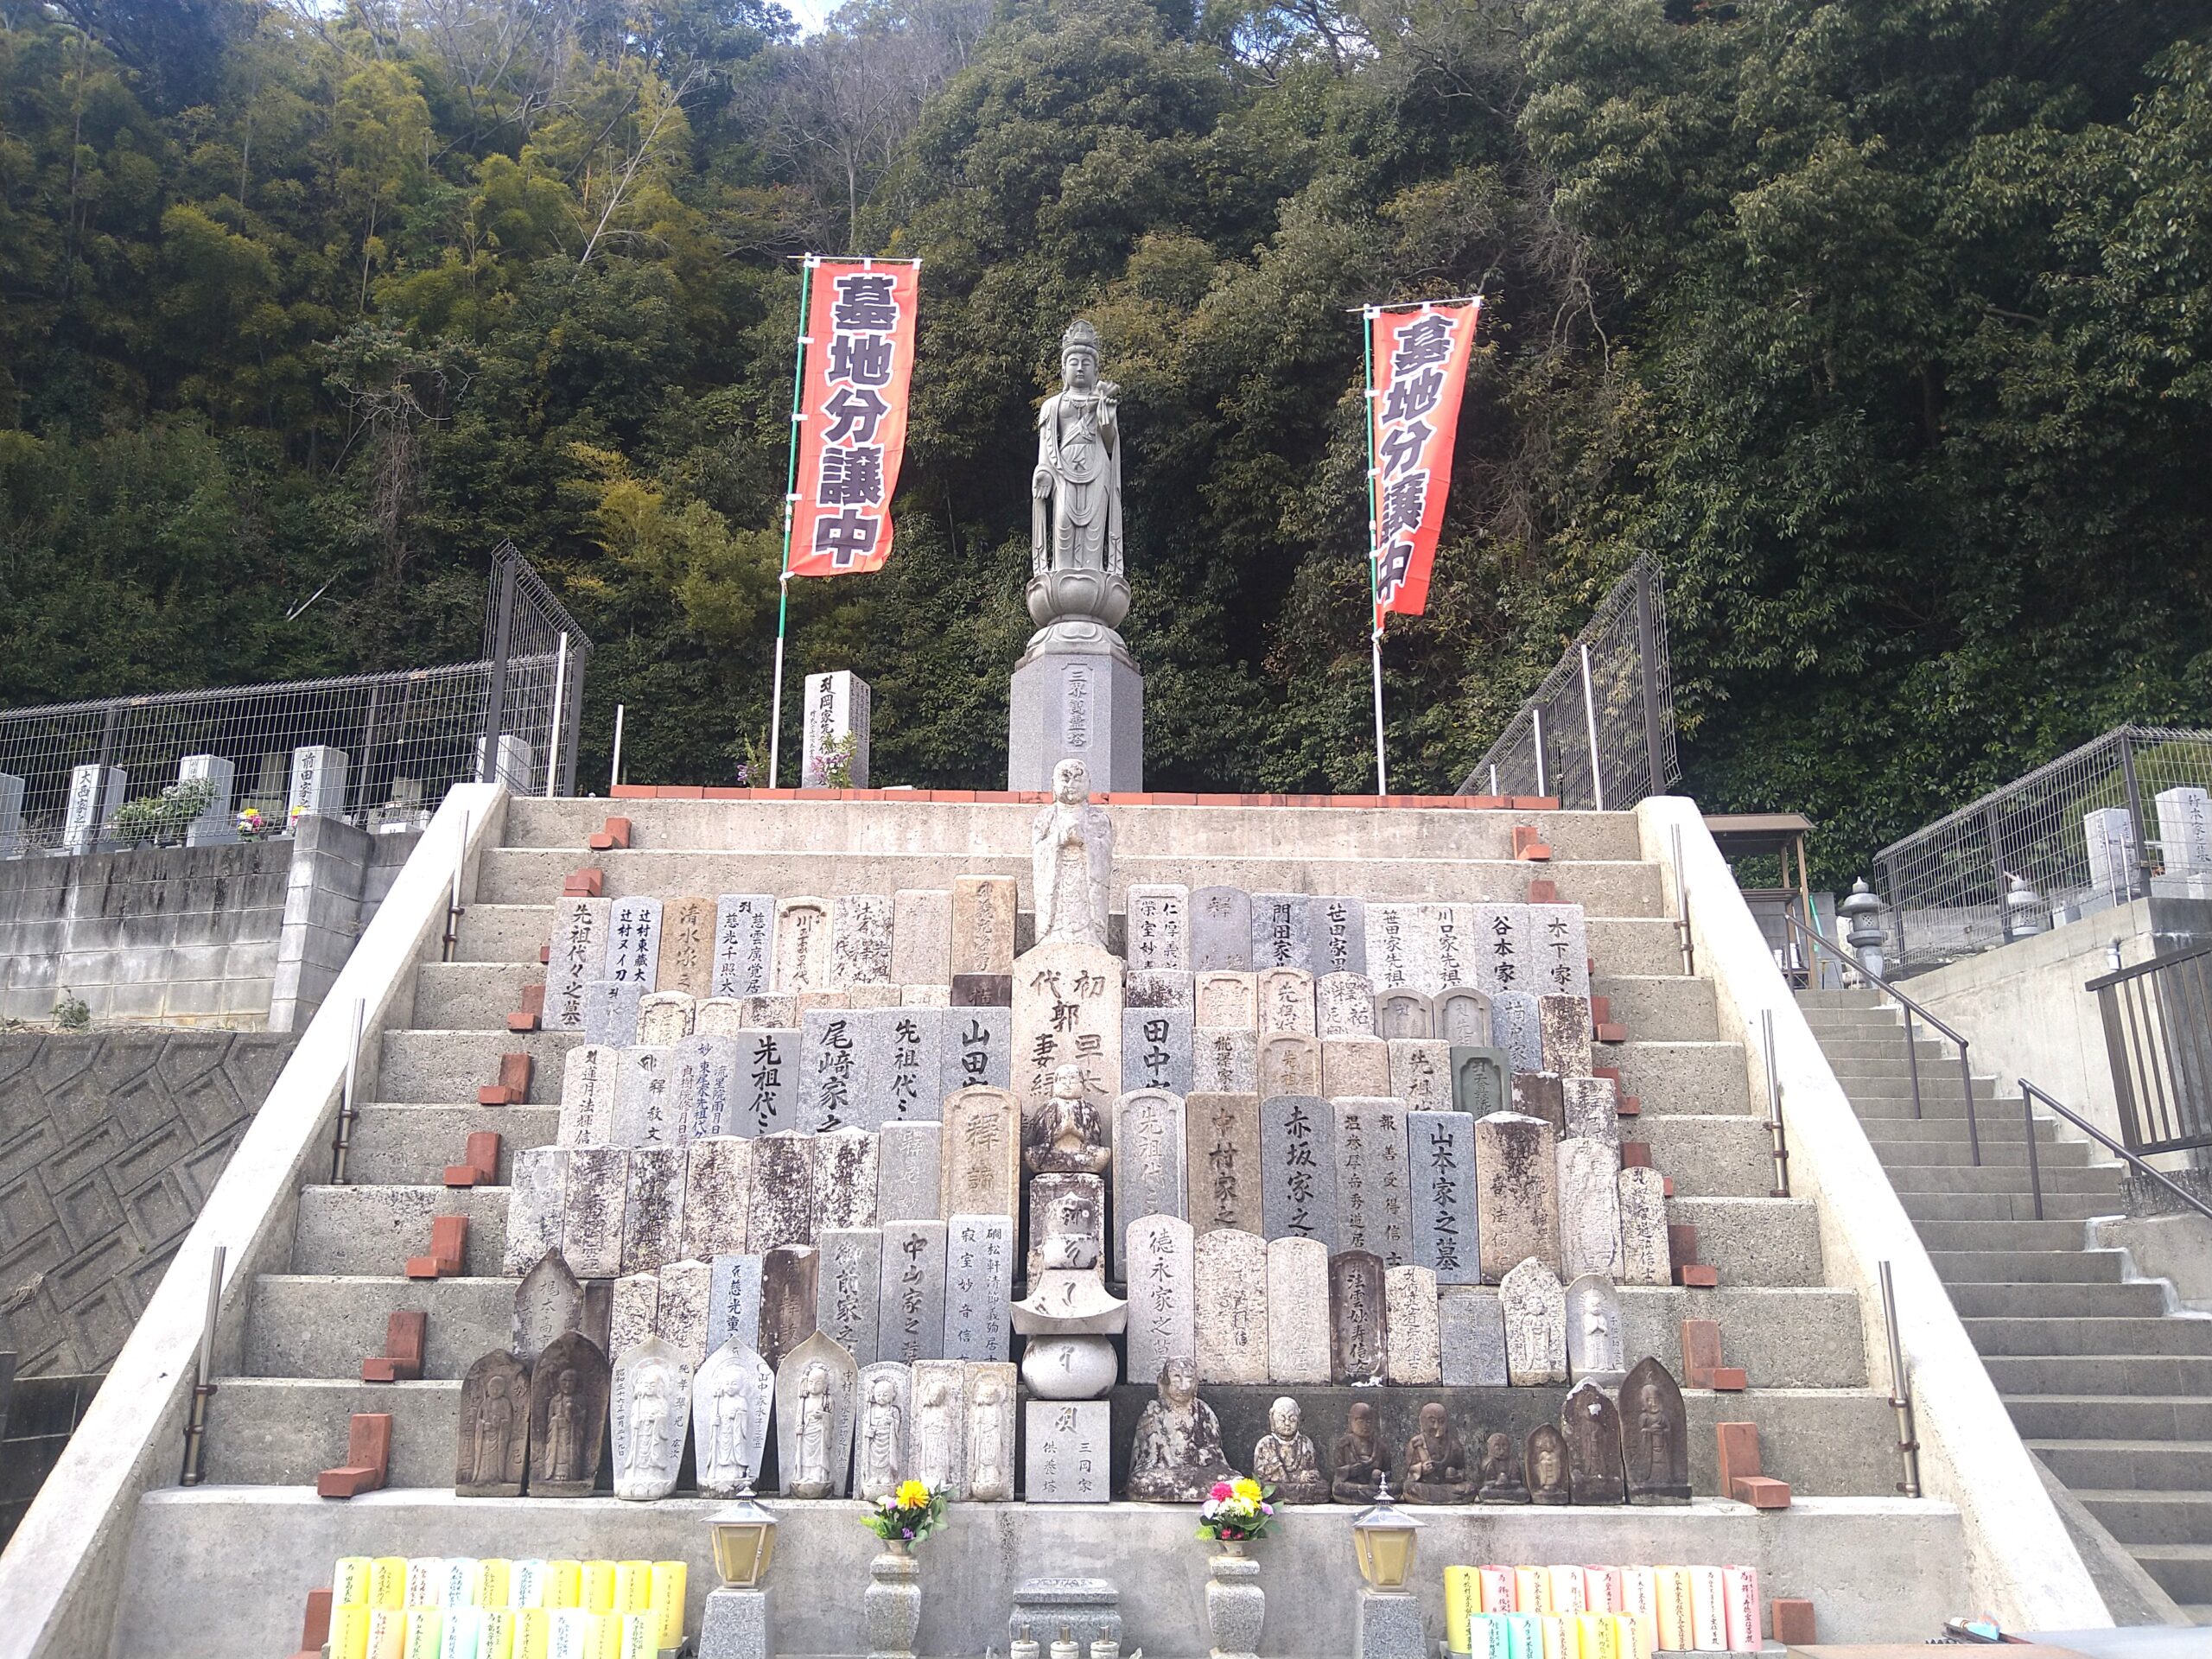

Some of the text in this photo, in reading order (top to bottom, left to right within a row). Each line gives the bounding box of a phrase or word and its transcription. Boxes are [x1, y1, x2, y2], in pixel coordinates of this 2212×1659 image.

[810, 273, 899, 569] 墓地分譲中
[562, 904, 593, 1026] 先祖代々之墓
[719, 912, 739, 996] 慈光千照大
[1163, 902, 1179, 969] 仁厚義
[1273, 903, 1293, 967] 門田家
[1382, 910, 1406, 988] 笹田家先祖
[1438, 907, 1462, 988] 川口家先祖
[1492, 915, 1516, 991] 谷本家
[1548, 917, 1571, 994] 木下家
[748, 1033, 783, 1137] 先祖代々
[890, 1019, 921, 1121] 先祖代々
[1210, 1108, 1238, 1225] 中村家之
[1283, 1105, 1317, 1237] 赤坂家之
[1429, 1122, 1461, 1271] 山本家之墓
[725, 1281, 742, 1341] 慈光童
[1042, 1440, 1058, 1493] 供養塔
